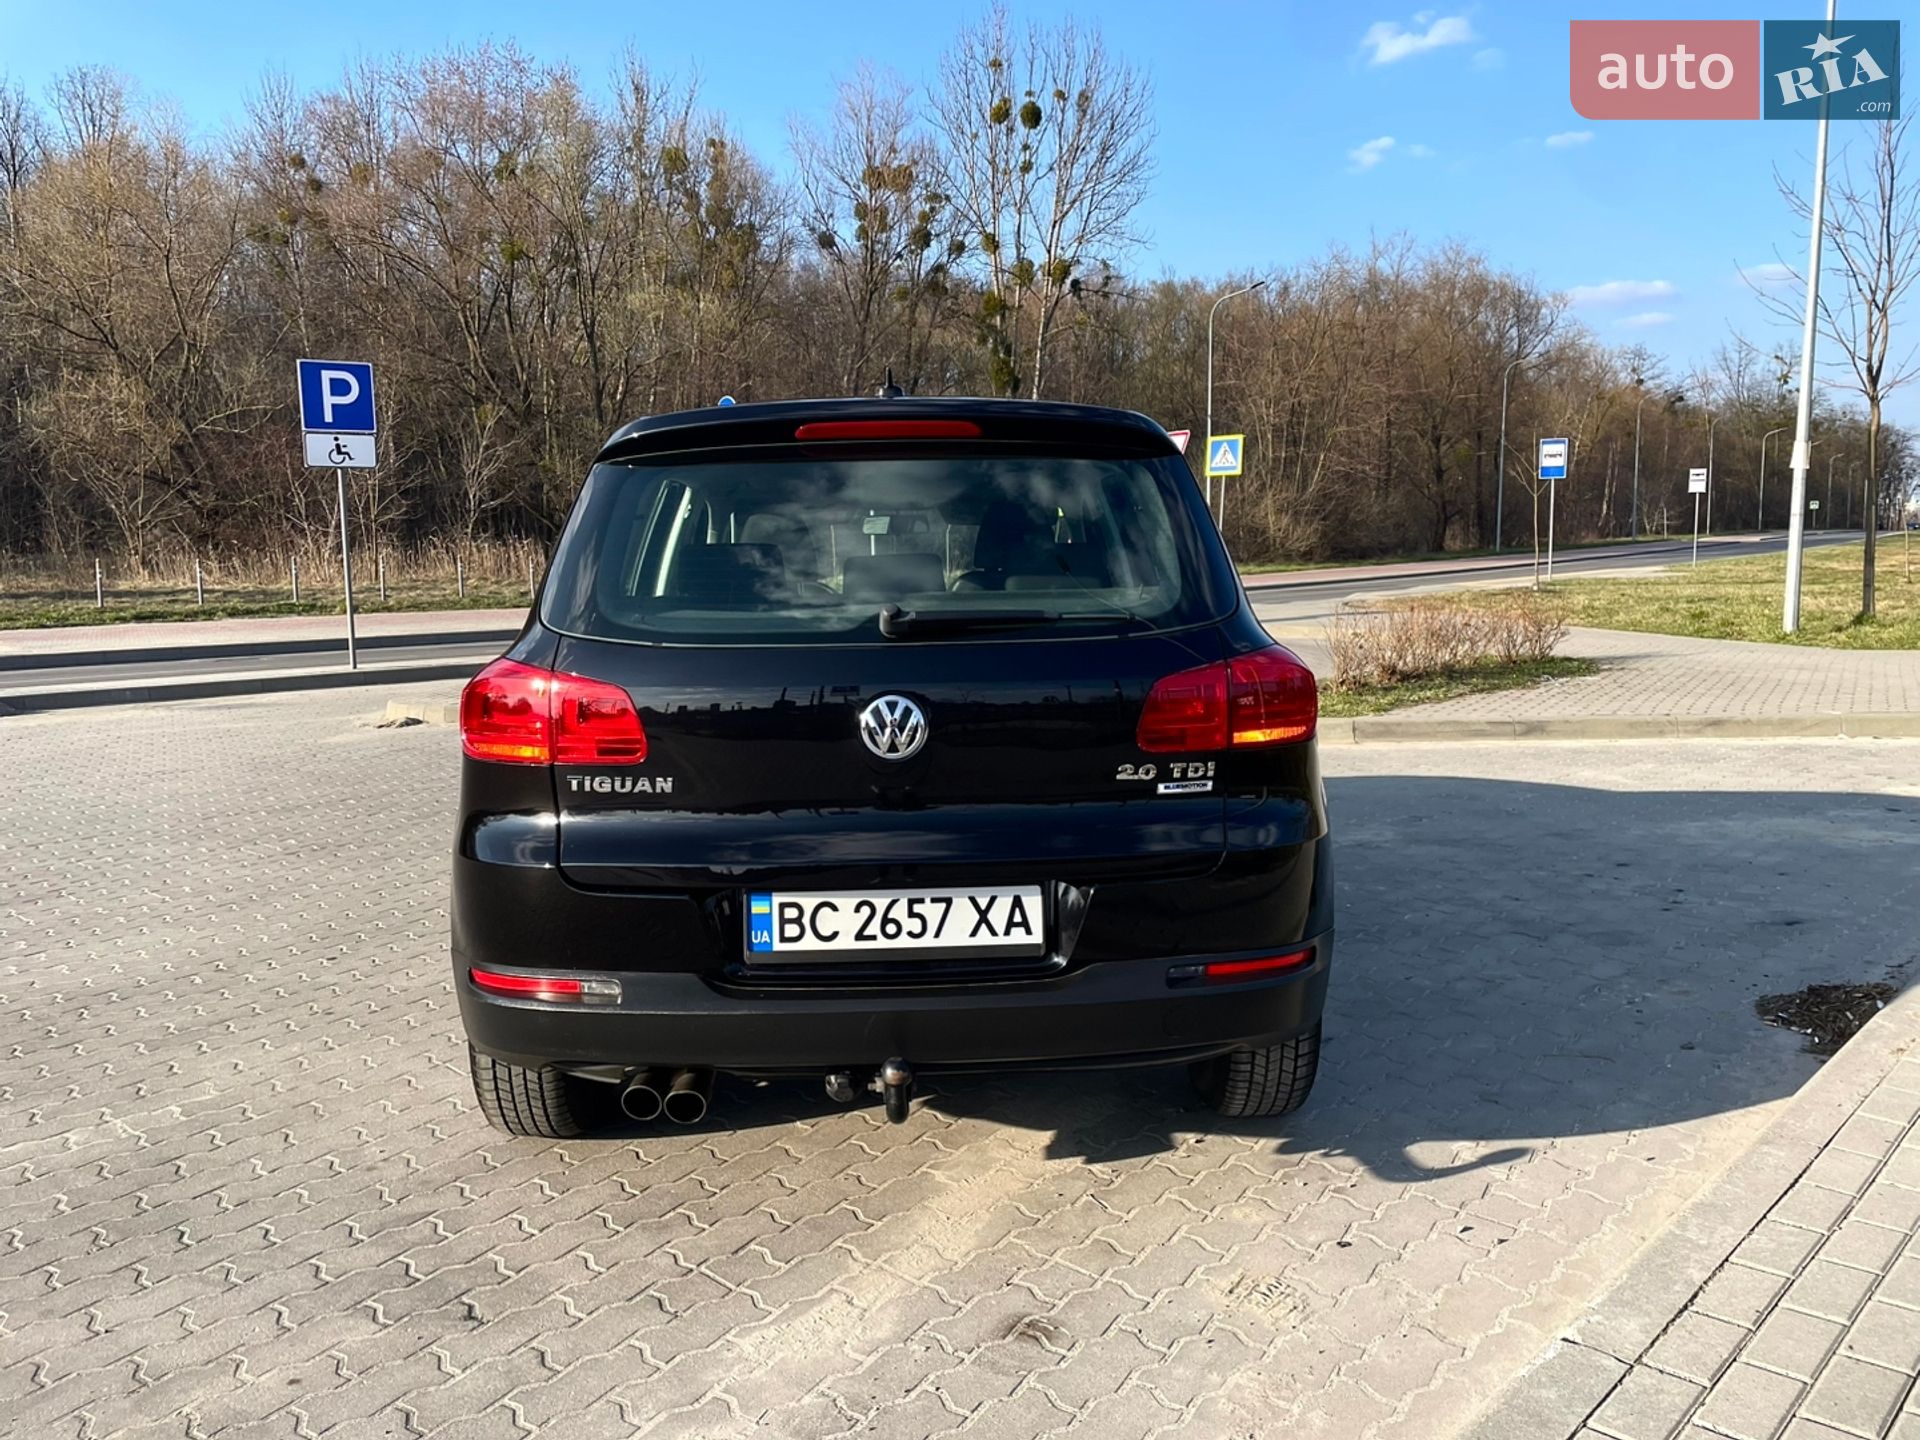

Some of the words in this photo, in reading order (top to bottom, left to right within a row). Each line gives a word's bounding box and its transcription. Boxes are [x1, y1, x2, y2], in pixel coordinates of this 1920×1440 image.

[321, 369, 360, 423] P
[566, 775, 673, 793] TIGUAN
[778, 901, 840, 944] BC
[853, 897, 953, 942] 2657
[967, 894, 1033, 938] XA
[751, 930, 770, 943] UA
